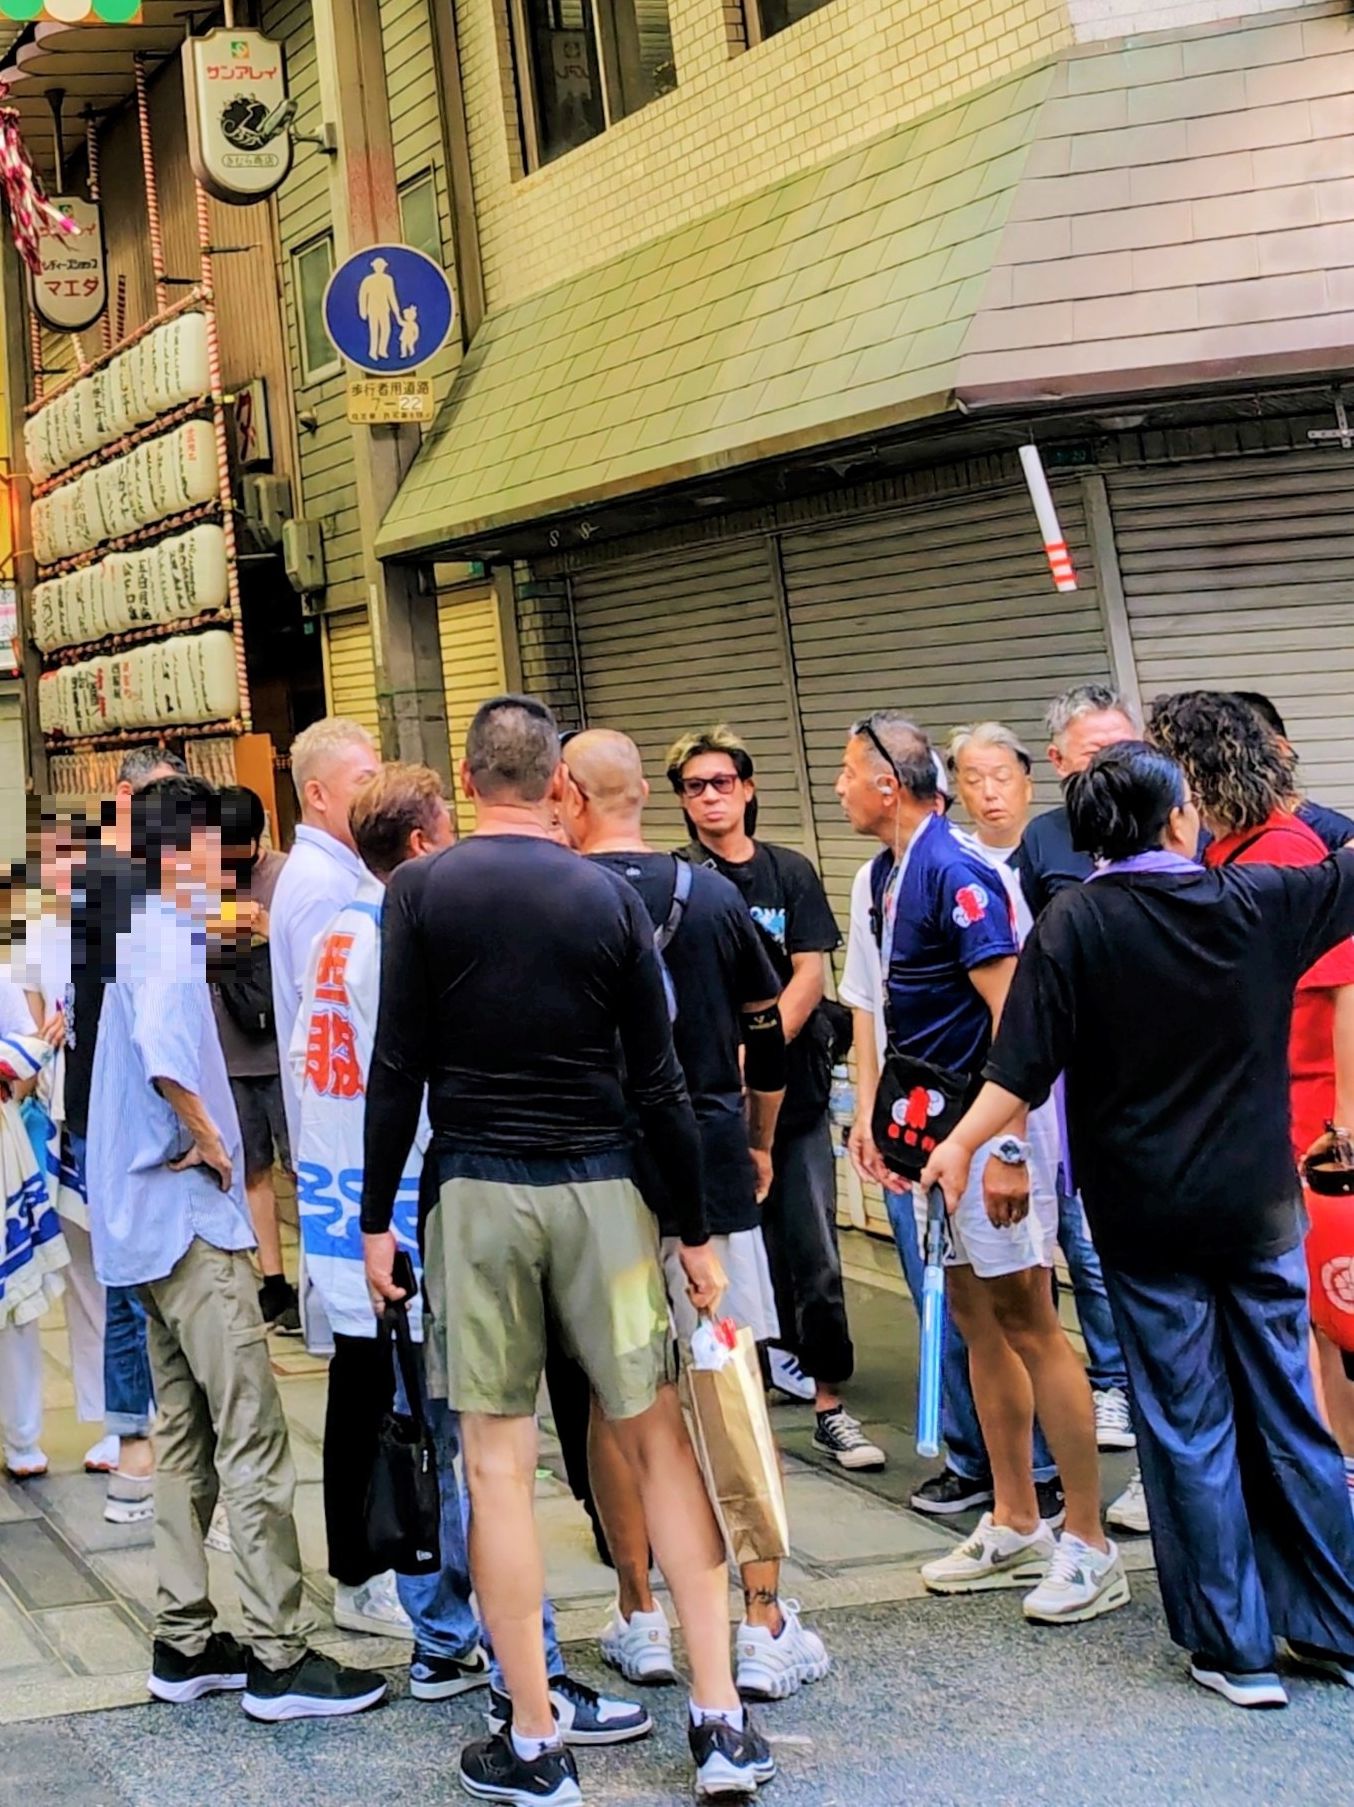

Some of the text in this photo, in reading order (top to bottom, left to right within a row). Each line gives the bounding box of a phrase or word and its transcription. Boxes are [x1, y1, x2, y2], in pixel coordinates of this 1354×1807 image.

[206, 65, 278, 80] サンアレイ
[44, 275, 100, 297] マエダ
[351, 380, 431, 398] 歩行者用道路
